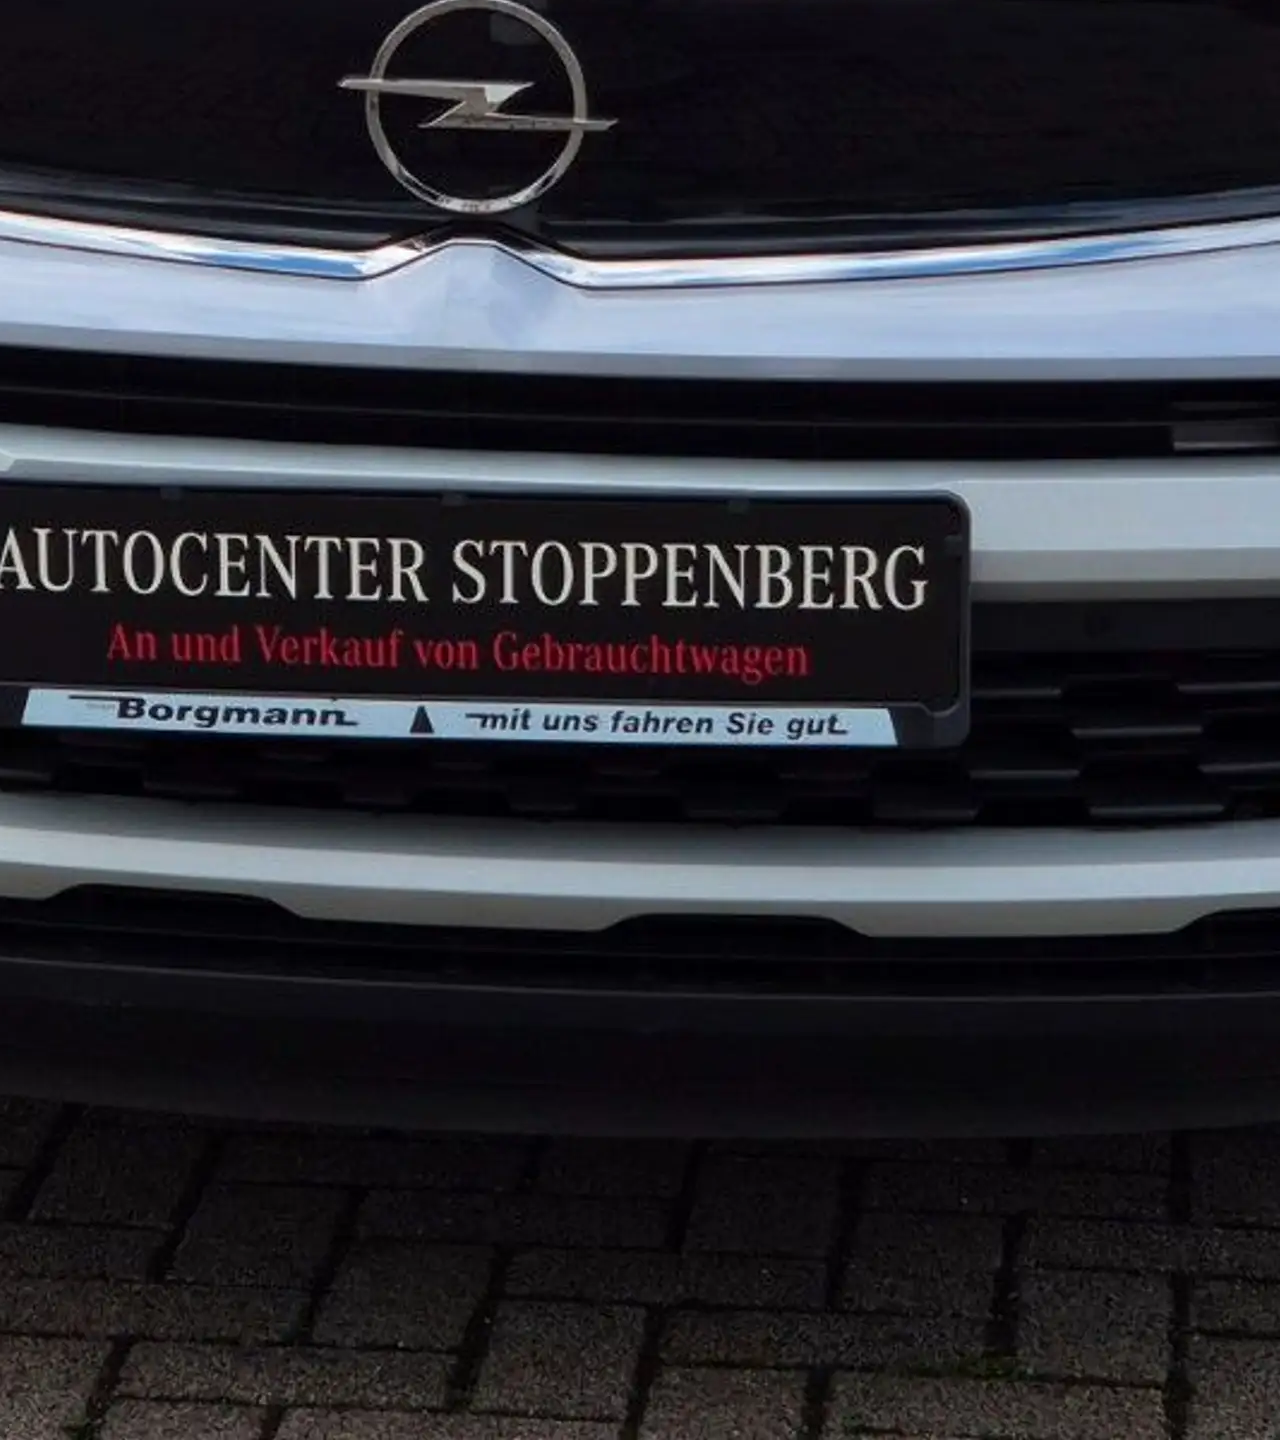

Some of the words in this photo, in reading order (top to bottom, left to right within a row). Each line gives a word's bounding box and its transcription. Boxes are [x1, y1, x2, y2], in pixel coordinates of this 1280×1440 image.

[452, 539, 928, 611] STOPPENBERG
[107, 624, 156, 660] An
[172, 626, 240, 663] und
[256, 626, 404, 668] Verkauf
[414, 639, 478, 669] von
[493, 631, 810, 684] Gebrauchtwagen
[114, 697, 359, 728] Borgmann
[469, 708, 532, 731] mit
[542, 713, 599, 733] uns
[610, 710, 713, 736] fahren
[726, 713, 777, 737] Sie
[786, 714, 849, 741] gut
